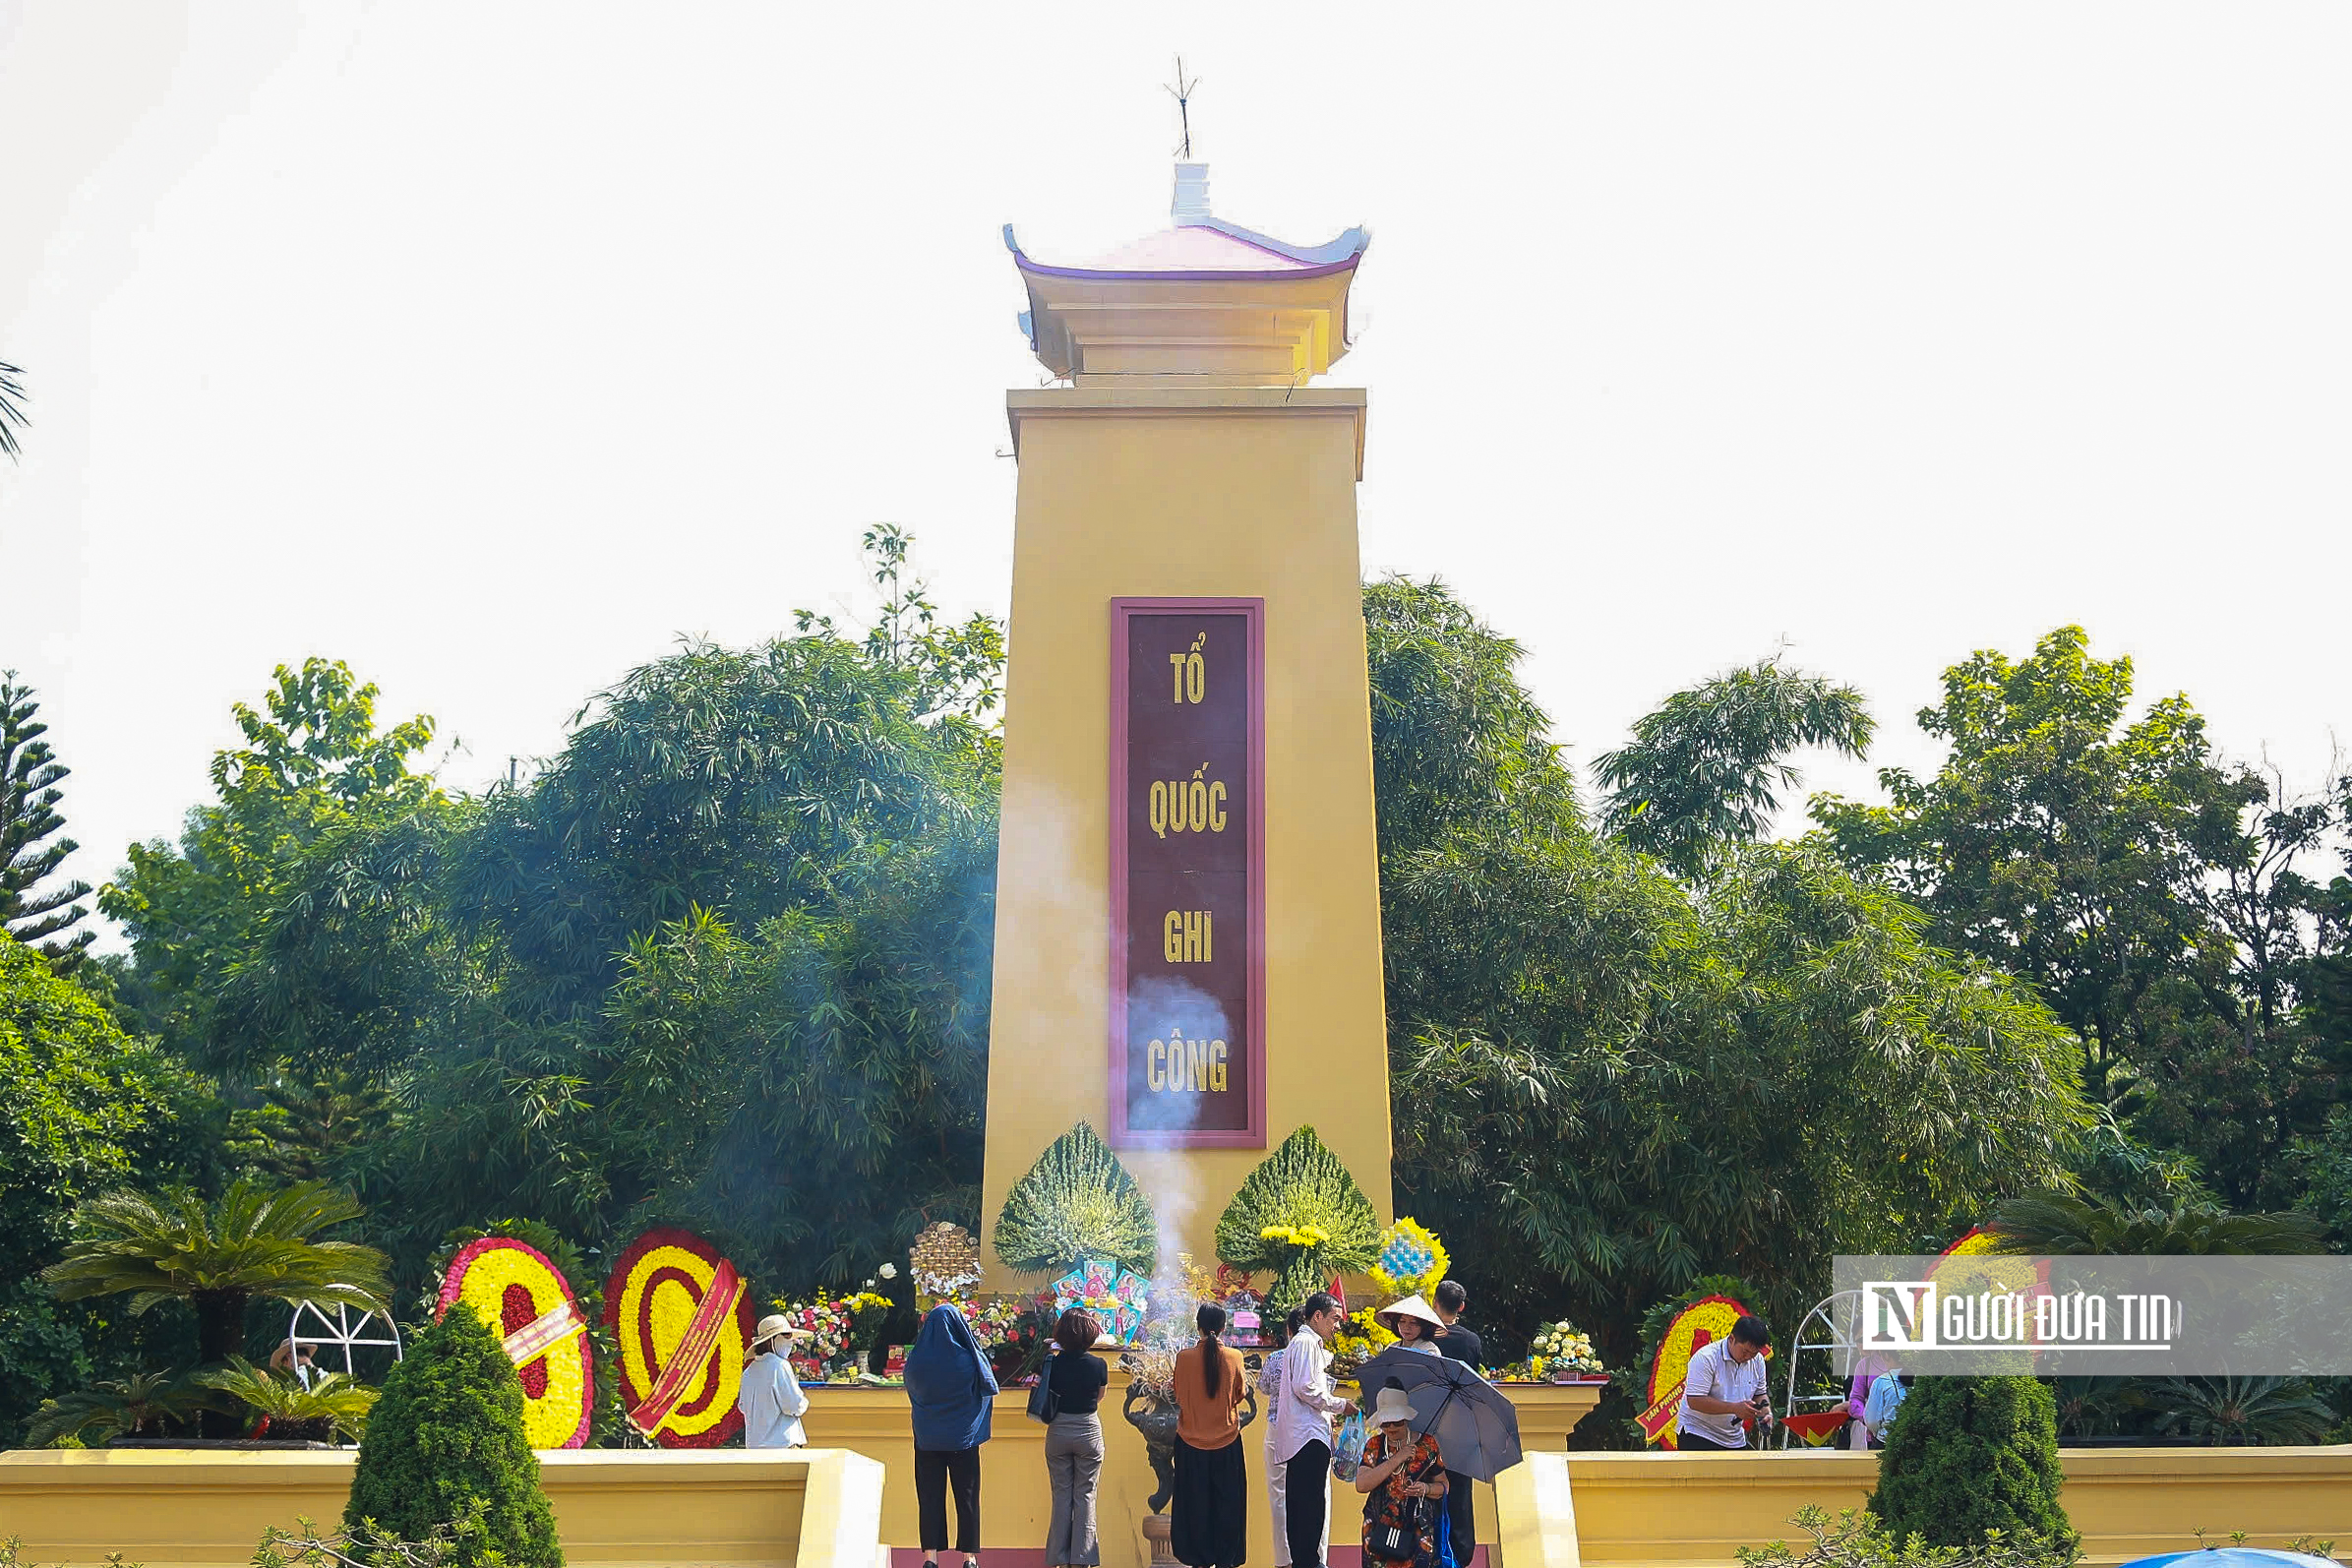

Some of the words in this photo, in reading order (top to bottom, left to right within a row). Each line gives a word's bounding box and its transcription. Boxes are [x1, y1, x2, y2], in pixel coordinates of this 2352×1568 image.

[1170, 631, 1207, 704] TỔ
[1149, 761, 1228, 839] QUỐC
[1164, 910, 1212, 963] GHI
[1147, 1027, 1228, 1093] CÔNG
